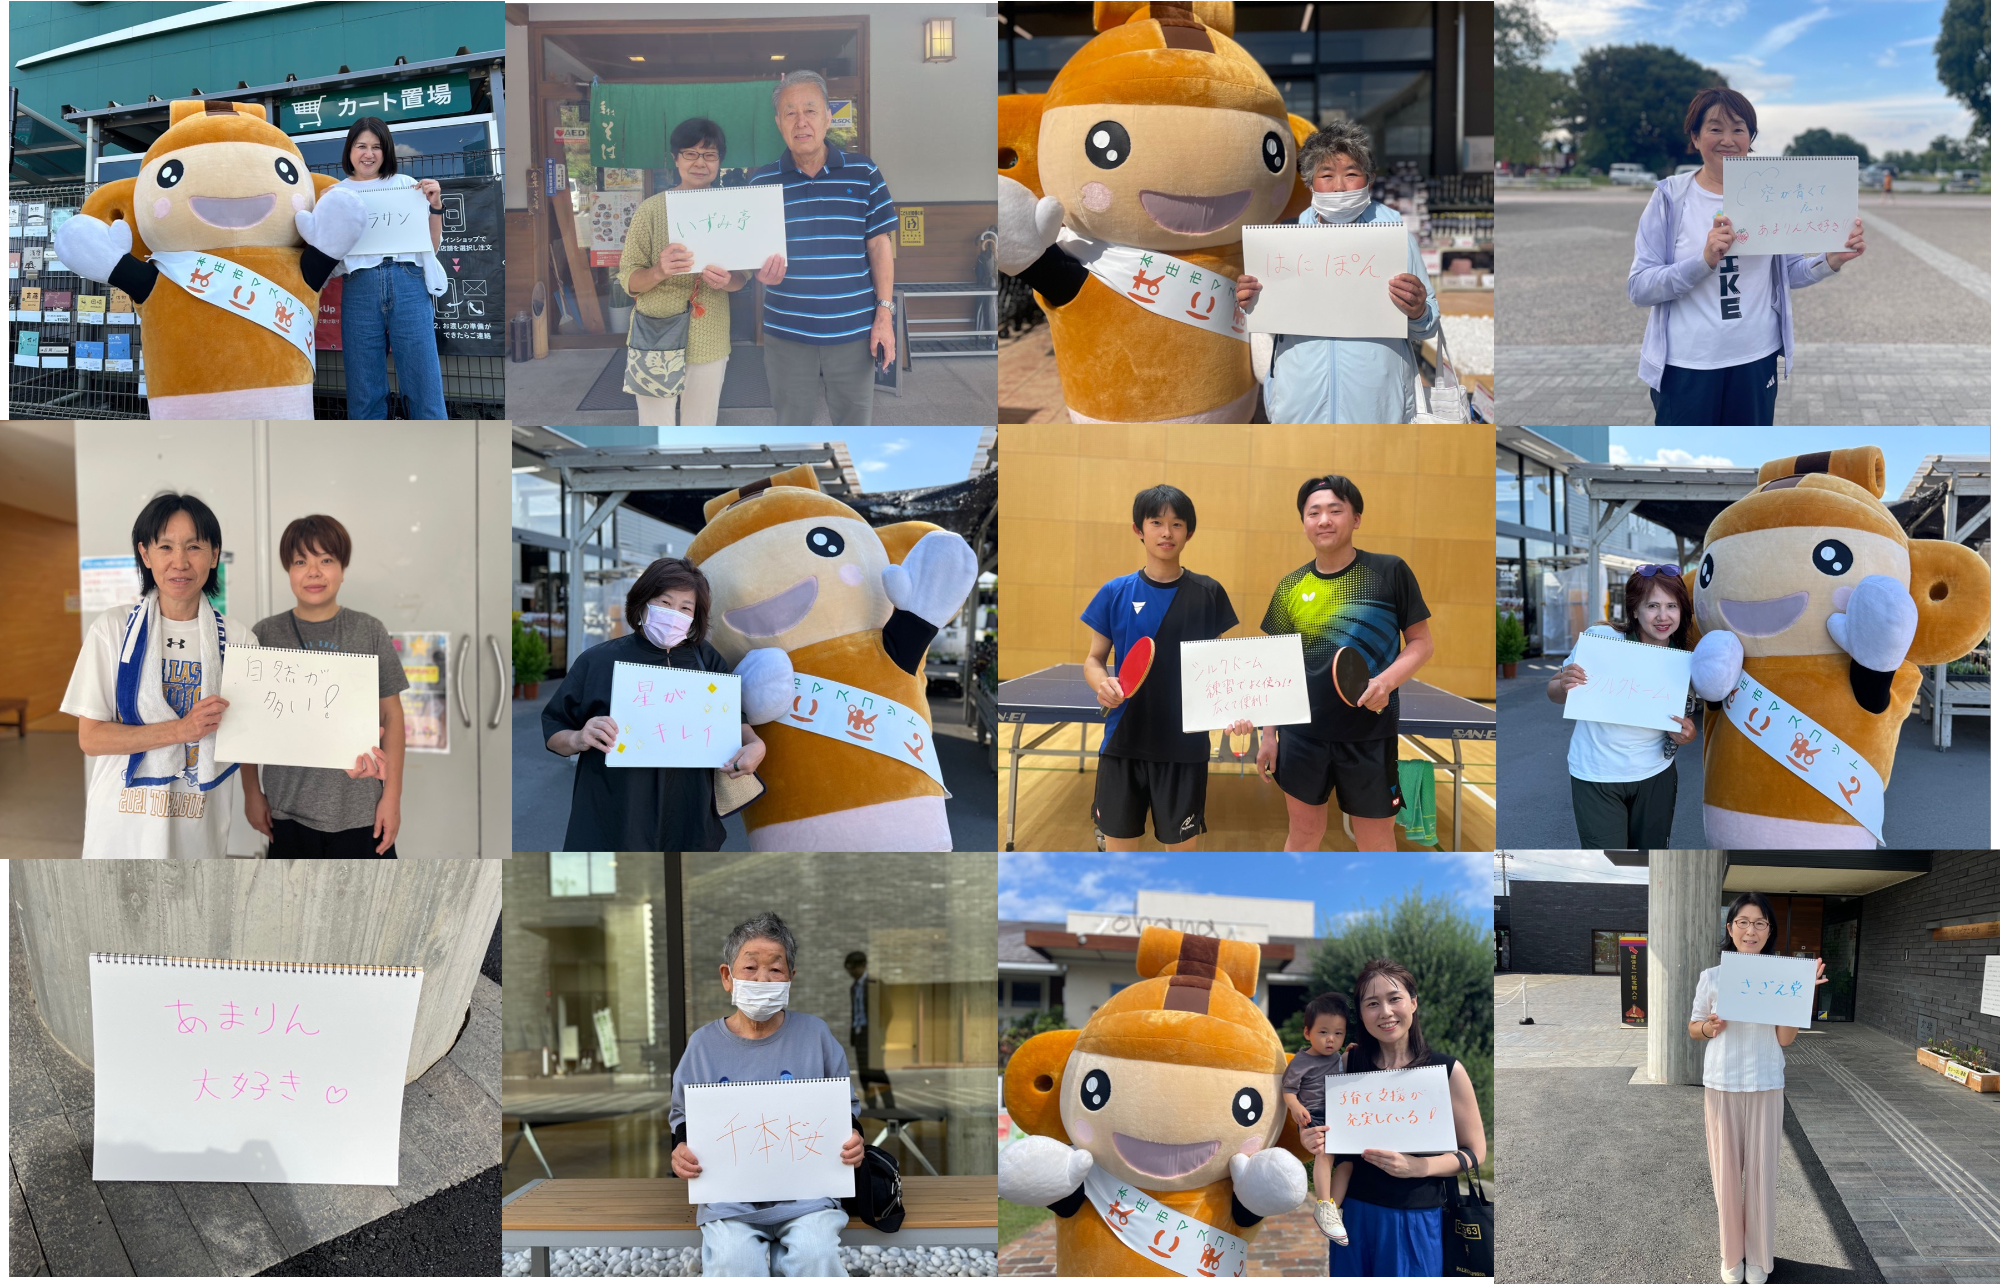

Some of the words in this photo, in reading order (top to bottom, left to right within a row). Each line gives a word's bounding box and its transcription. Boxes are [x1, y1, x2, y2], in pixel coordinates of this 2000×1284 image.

[338, 83, 452, 117] カート置場
[564, 129, 586, 137] AED
[1760, 183, 1826, 203] 空が青くて
[368, 211, 411, 229] ラサン
[676, 209, 751, 238] いずみ亭
[1266, 253, 1381, 278] はにぽん
[196, 256, 313, 326] 本庄市マスコット
[246, 655, 330, 686] 自然が
[1191, 655, 1263, 682] シルクドーム
[632, 680, 687, 708] 星が
[651, 722, 713, 748] キレイ
[118, 787, 147, 815] 2021
[1740, 978, 1804, 998] さざえ堂
[163, 999, 321, 1036] あまりん
[192, 1068, 302, 1102] 大好き
[1339, 1086, 1427, 1106] 子育て支援が
[715, 1112, 828, 1167] 千本桜
[1116, 1185, 1246, 1255] 本庄市マスコット
